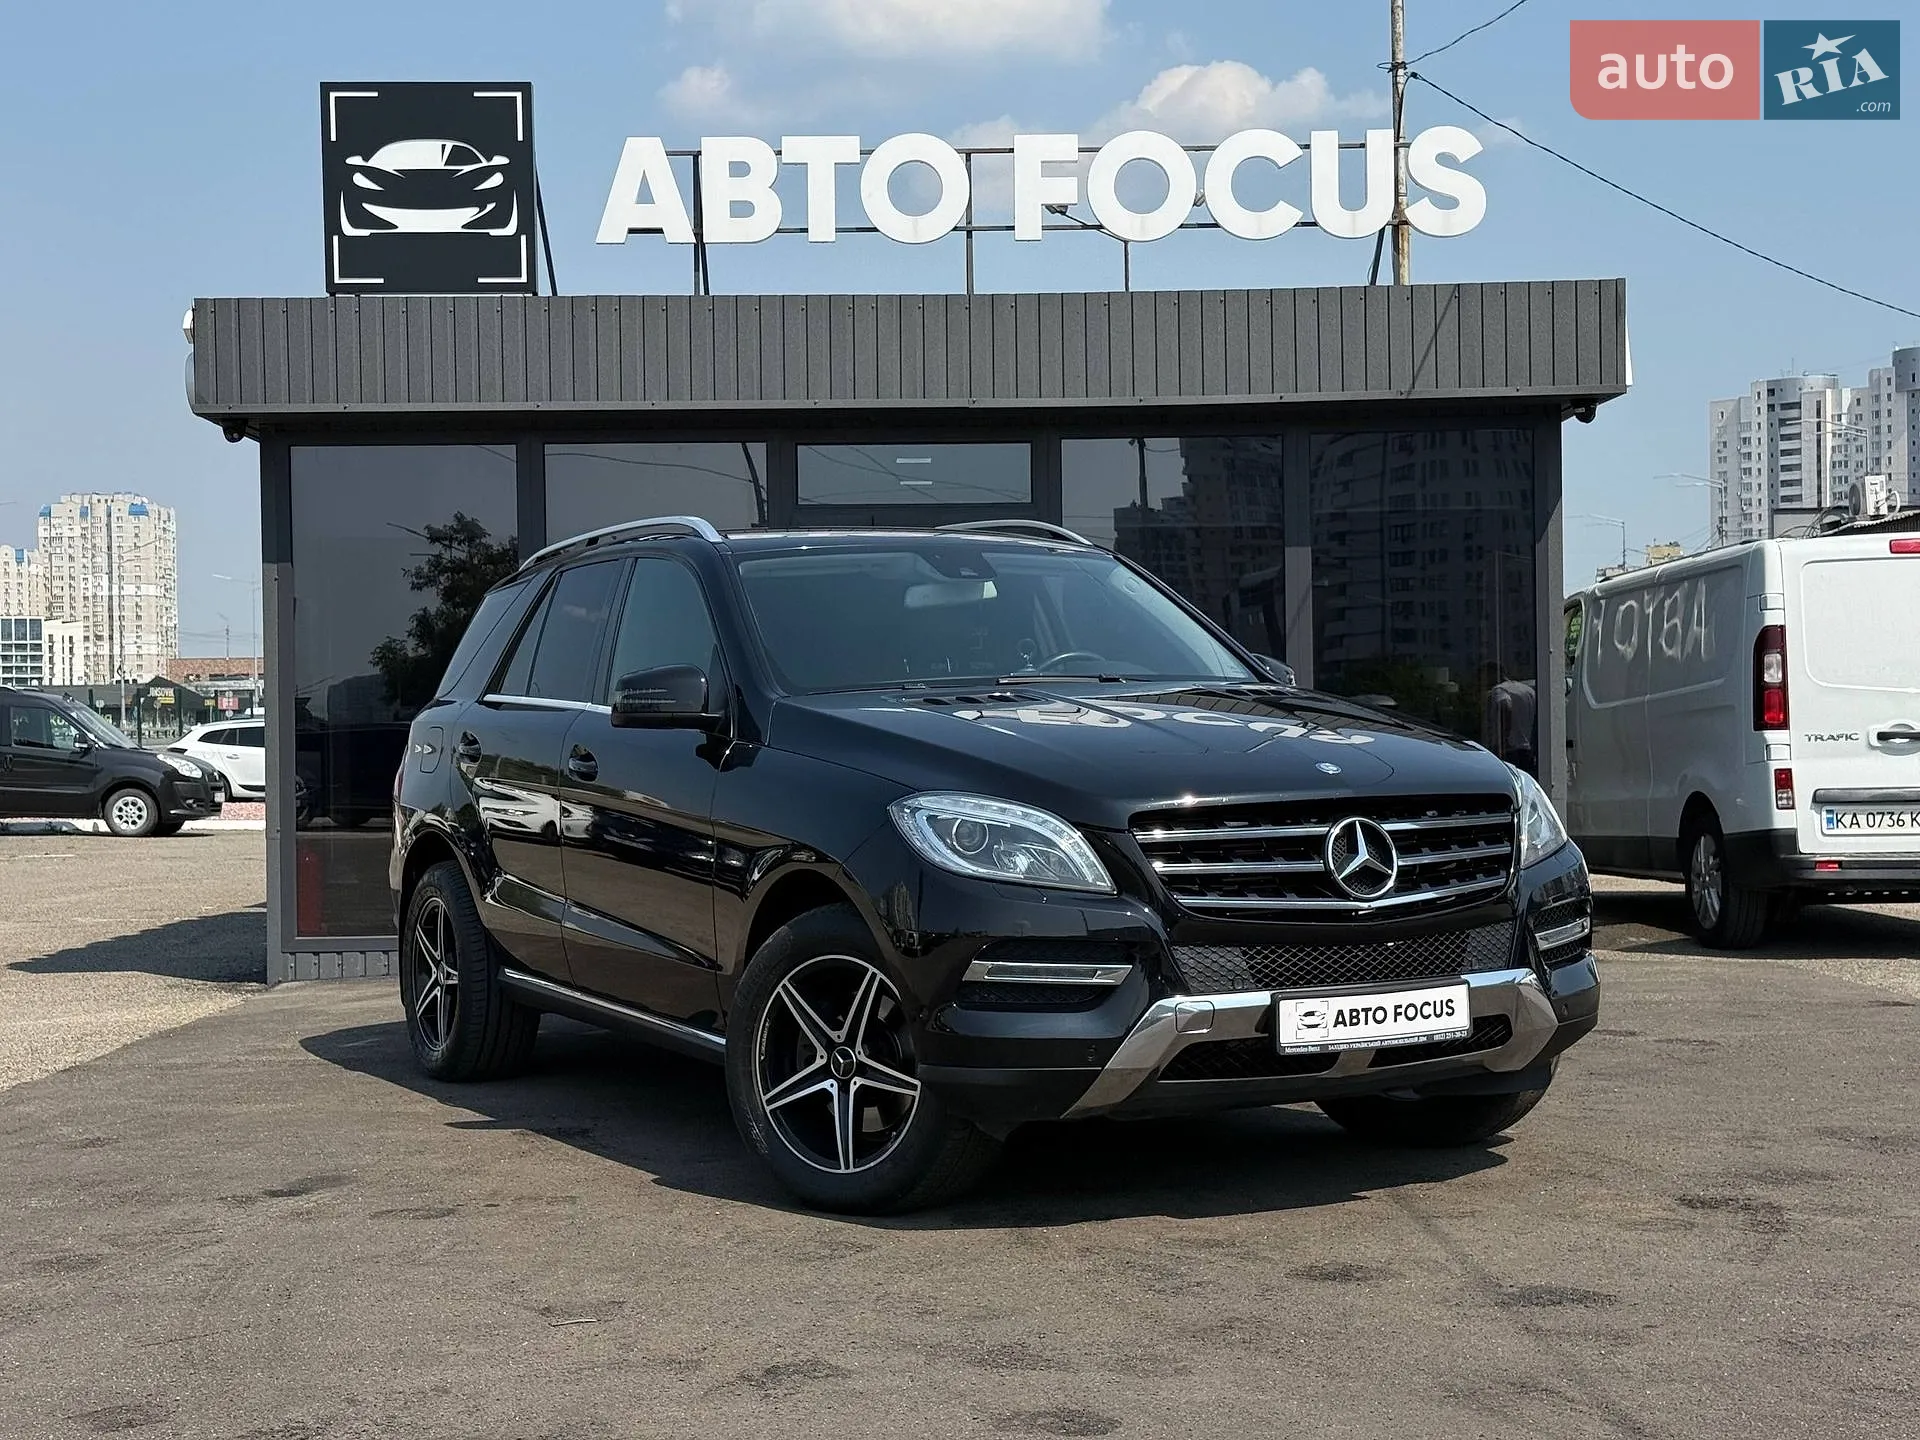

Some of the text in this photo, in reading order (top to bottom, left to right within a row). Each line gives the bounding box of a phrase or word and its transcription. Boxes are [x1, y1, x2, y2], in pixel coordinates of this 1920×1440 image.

[596, 126, 1488, 245] АВТО FOCUS
[1804, 733, 1860, 742] TRAFIC
[1835, 811, 1861, 829] KA
[1866, 811, 1905, 828] 0736
[1333, 998, 1456, 1028] АВТО FOCUS
